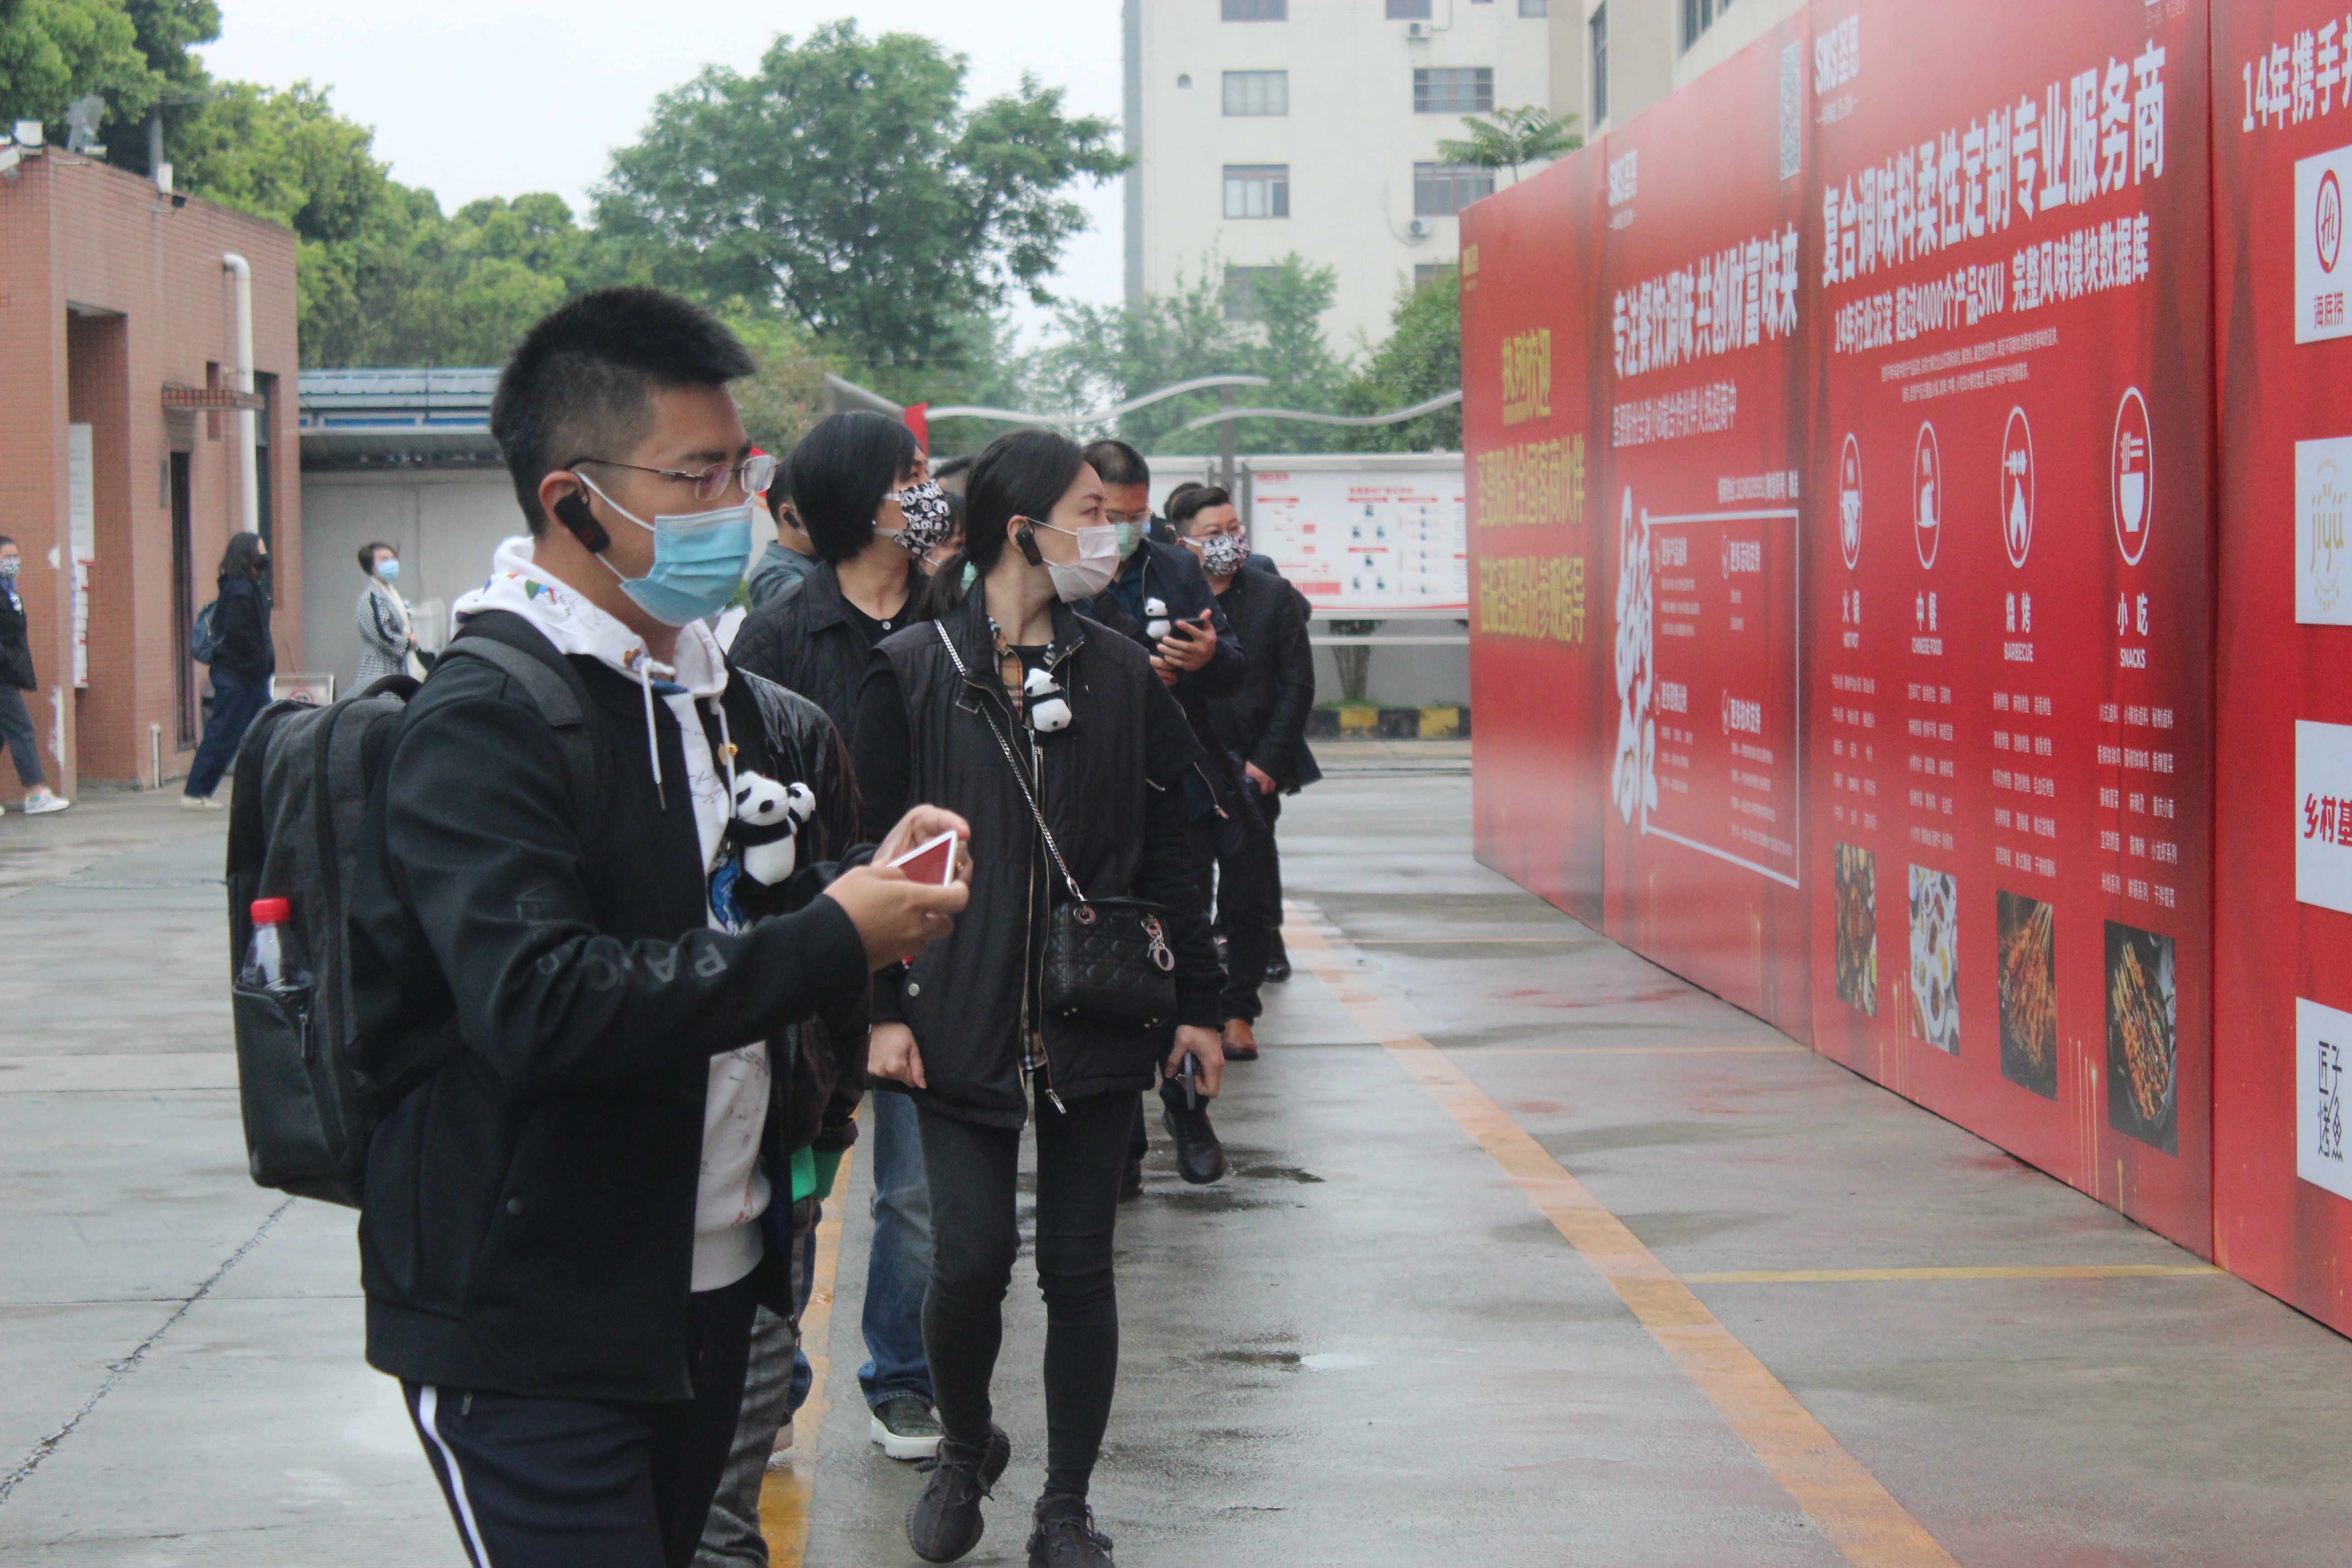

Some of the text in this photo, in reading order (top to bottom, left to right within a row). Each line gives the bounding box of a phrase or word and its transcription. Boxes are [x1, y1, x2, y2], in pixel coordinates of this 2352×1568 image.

[1822, 39, 2166, 289] 复合调味料柔性定制专业服务商
[1835, 291, 1893, 355] 14年行业沉淀
[1896, 261, 2004, 341] 超过4000个产品SKU
[2012, 211, 2149, 314] 完整风味模块数据库
[2314, 291, 2343, 329] 海底捞
[1916, 592, 1937, 632] 中餐
[2005, 591, 2031, 634] 烧烤
[2117, 591, 2149, 636] 小吃
[2004, 642, 2034, 662] BARBECUE
[2120, 648, 2146, 669] SNACKS
[2152, 752, 2173, 774] 香辣冒菜
[2153, 796, 2174, 818] 重庆小面
[2304, 793, 2352, 847] 乡村基
[2151, 840, 2177, 865] 小龙虾系列
